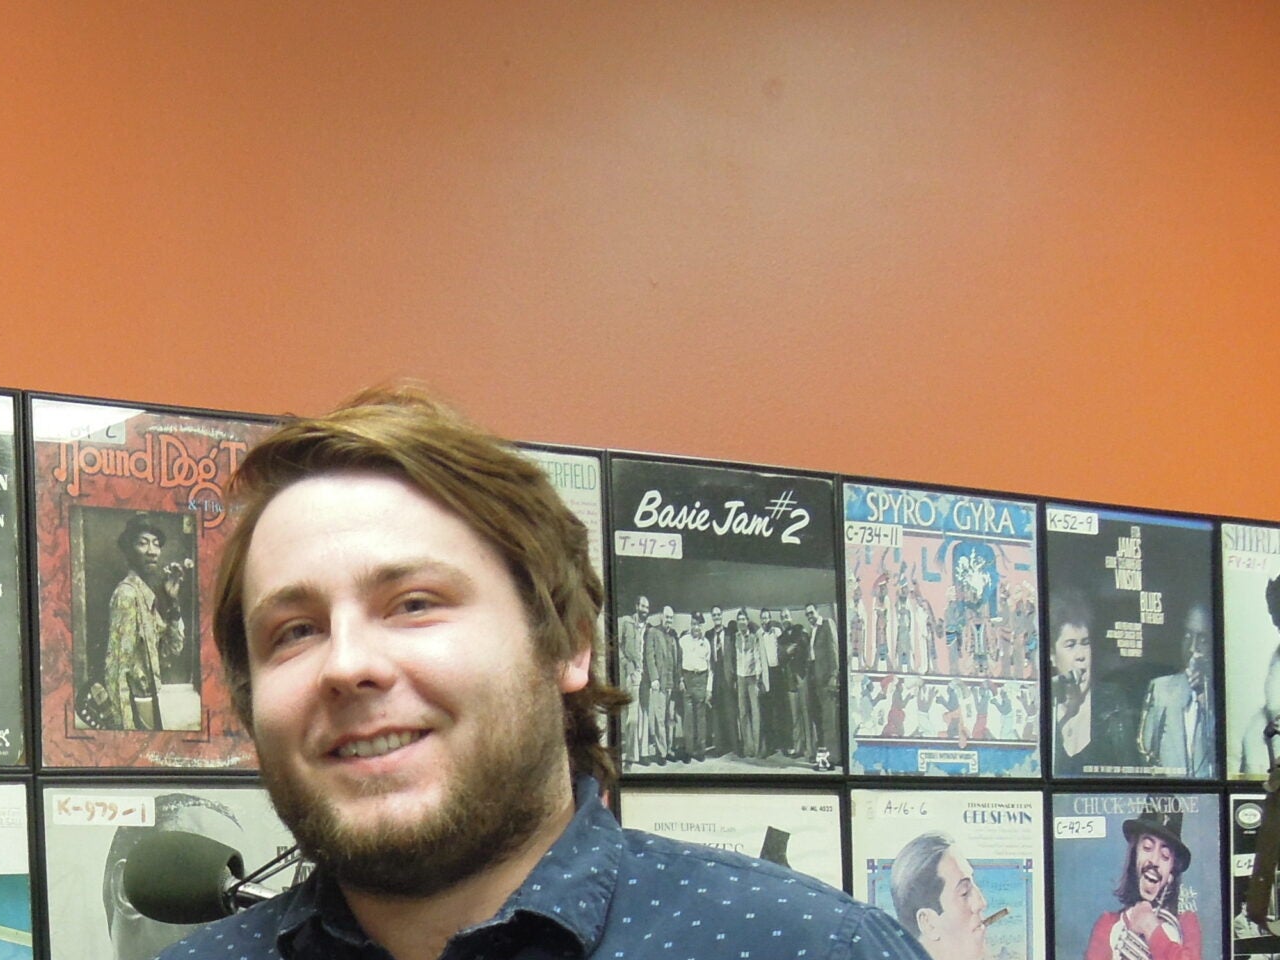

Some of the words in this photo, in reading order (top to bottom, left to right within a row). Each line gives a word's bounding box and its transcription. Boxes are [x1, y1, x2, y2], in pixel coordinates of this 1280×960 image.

[158, 434, 226, 528] Dog
[634, 490, 710, 531] Basie
[713, 500, 774, 538] Jam
[866, 492, 935, 527] SPYRO
[953, 500, 1015, 535] GYRA
[1048, 512, 1093, 532] K-52-9
[1074, 796, 1125, 814] CHUCK
[1127, 796, 1199, 814] MANGIONE
[654, 822, 677, 832] DINU
[680, 823, 717, 833] LIPATTI
[963, 810, 1032, 825] GERSHWIN
